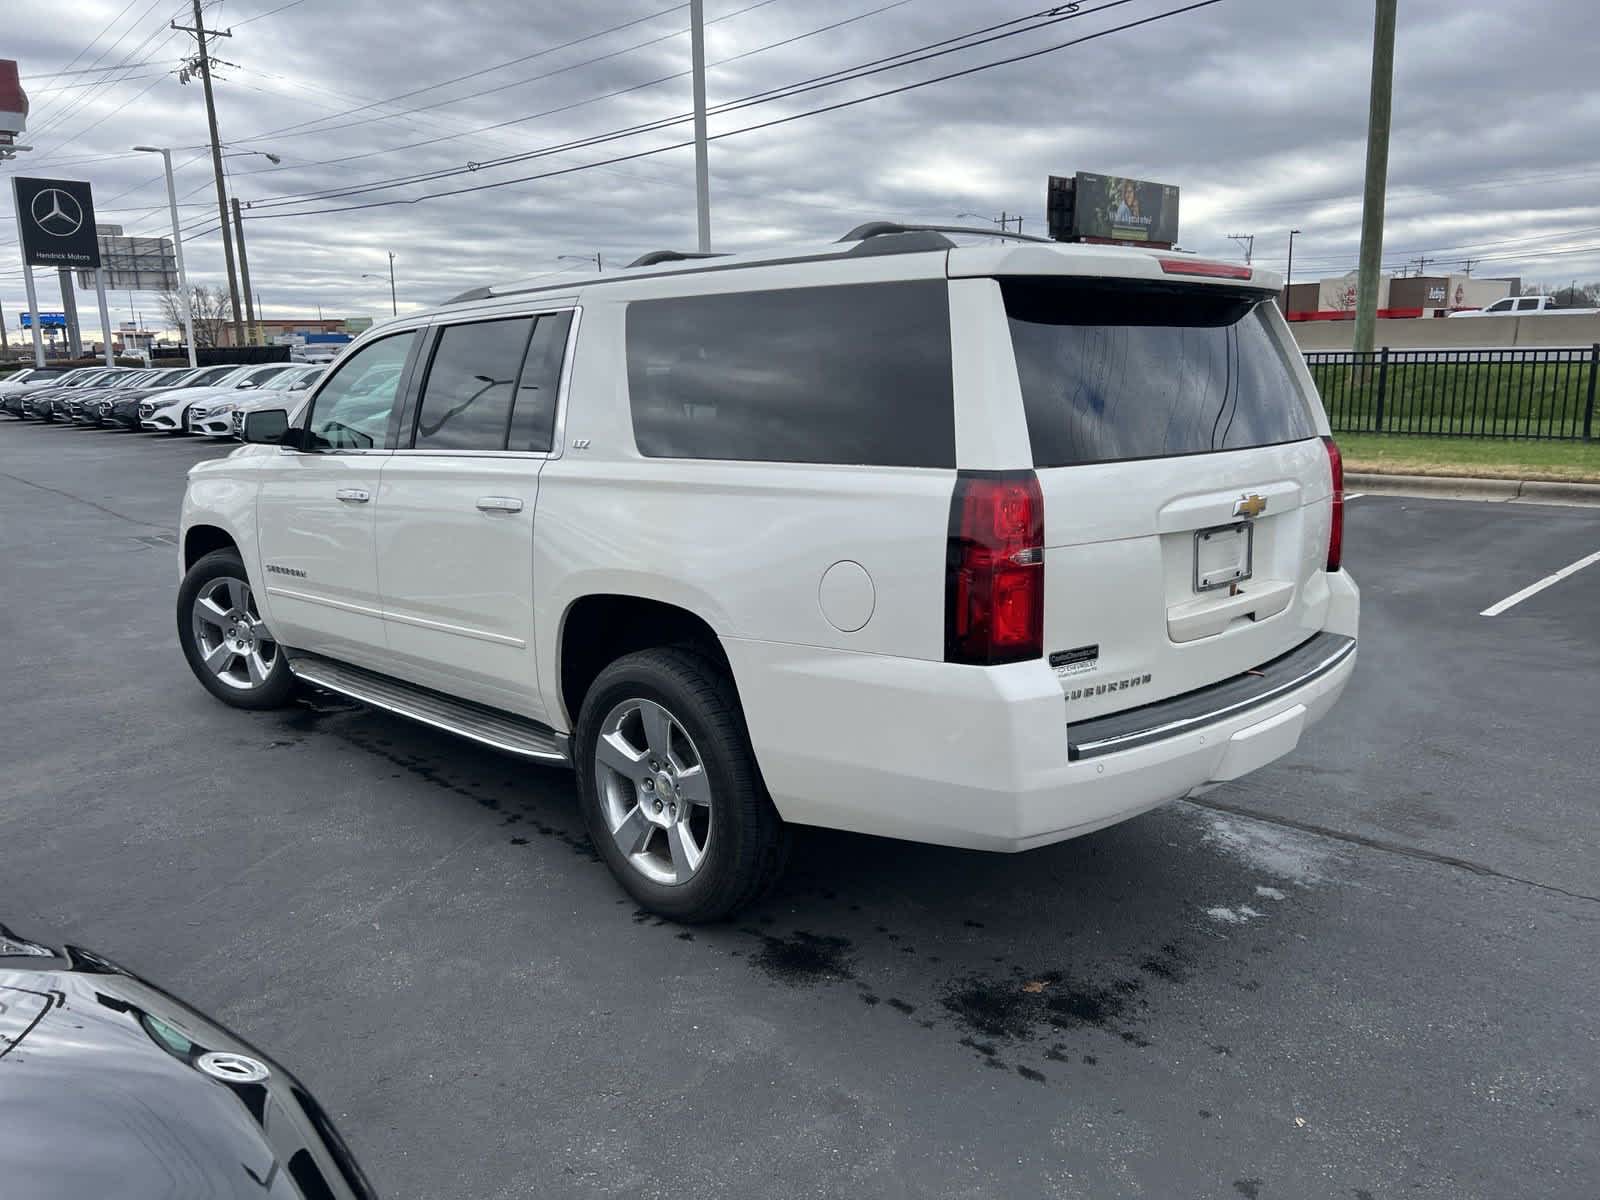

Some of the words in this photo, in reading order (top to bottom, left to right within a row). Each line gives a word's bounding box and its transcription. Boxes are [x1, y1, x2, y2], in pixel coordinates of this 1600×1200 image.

[36, 252, 66, 260] Hendrick
[67, 253, 91, 261] Motors
[572, 439, 591, 449] LTZ
